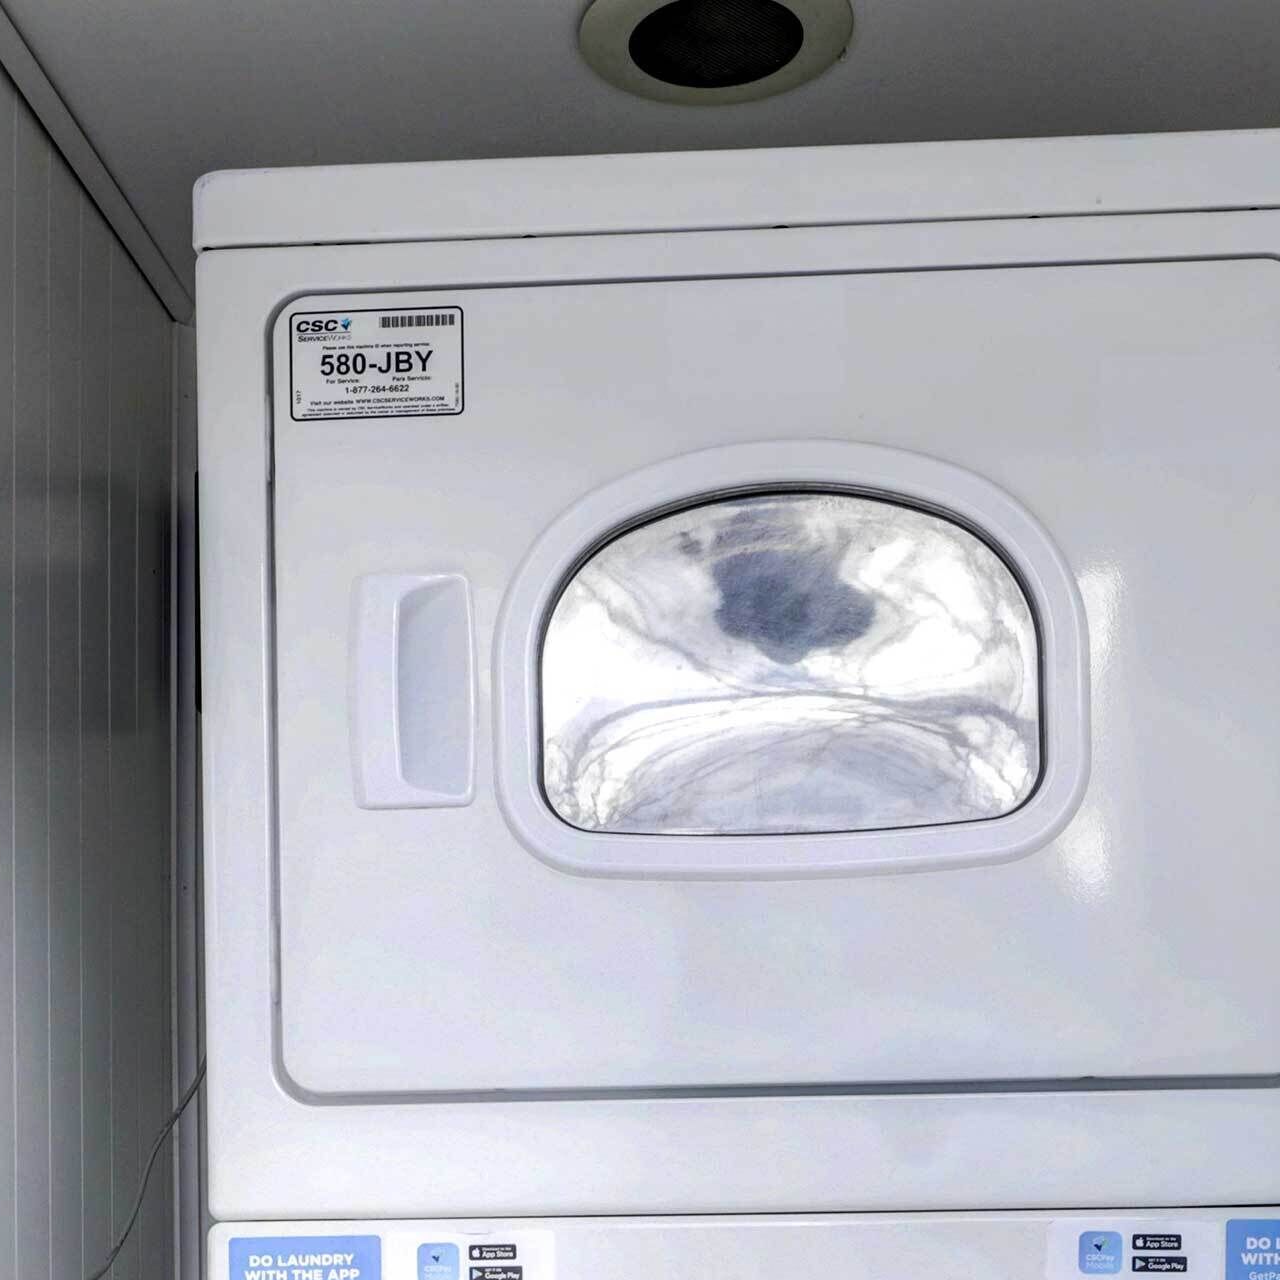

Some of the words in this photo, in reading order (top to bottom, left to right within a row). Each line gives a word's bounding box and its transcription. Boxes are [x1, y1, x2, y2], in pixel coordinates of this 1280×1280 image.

[296, 319, 339, 333] CSC
[320, 350, 433, 376] 580-JBY
[345, 384, 409, 394] 1-877-264-6622
[1246, 1237, 1271, 1250] DO
[249, 1255, 273, 1267] DO
[277, 1253, 354, 1267] LAUNDRY
[327, 1268, 360, 1280] APP
